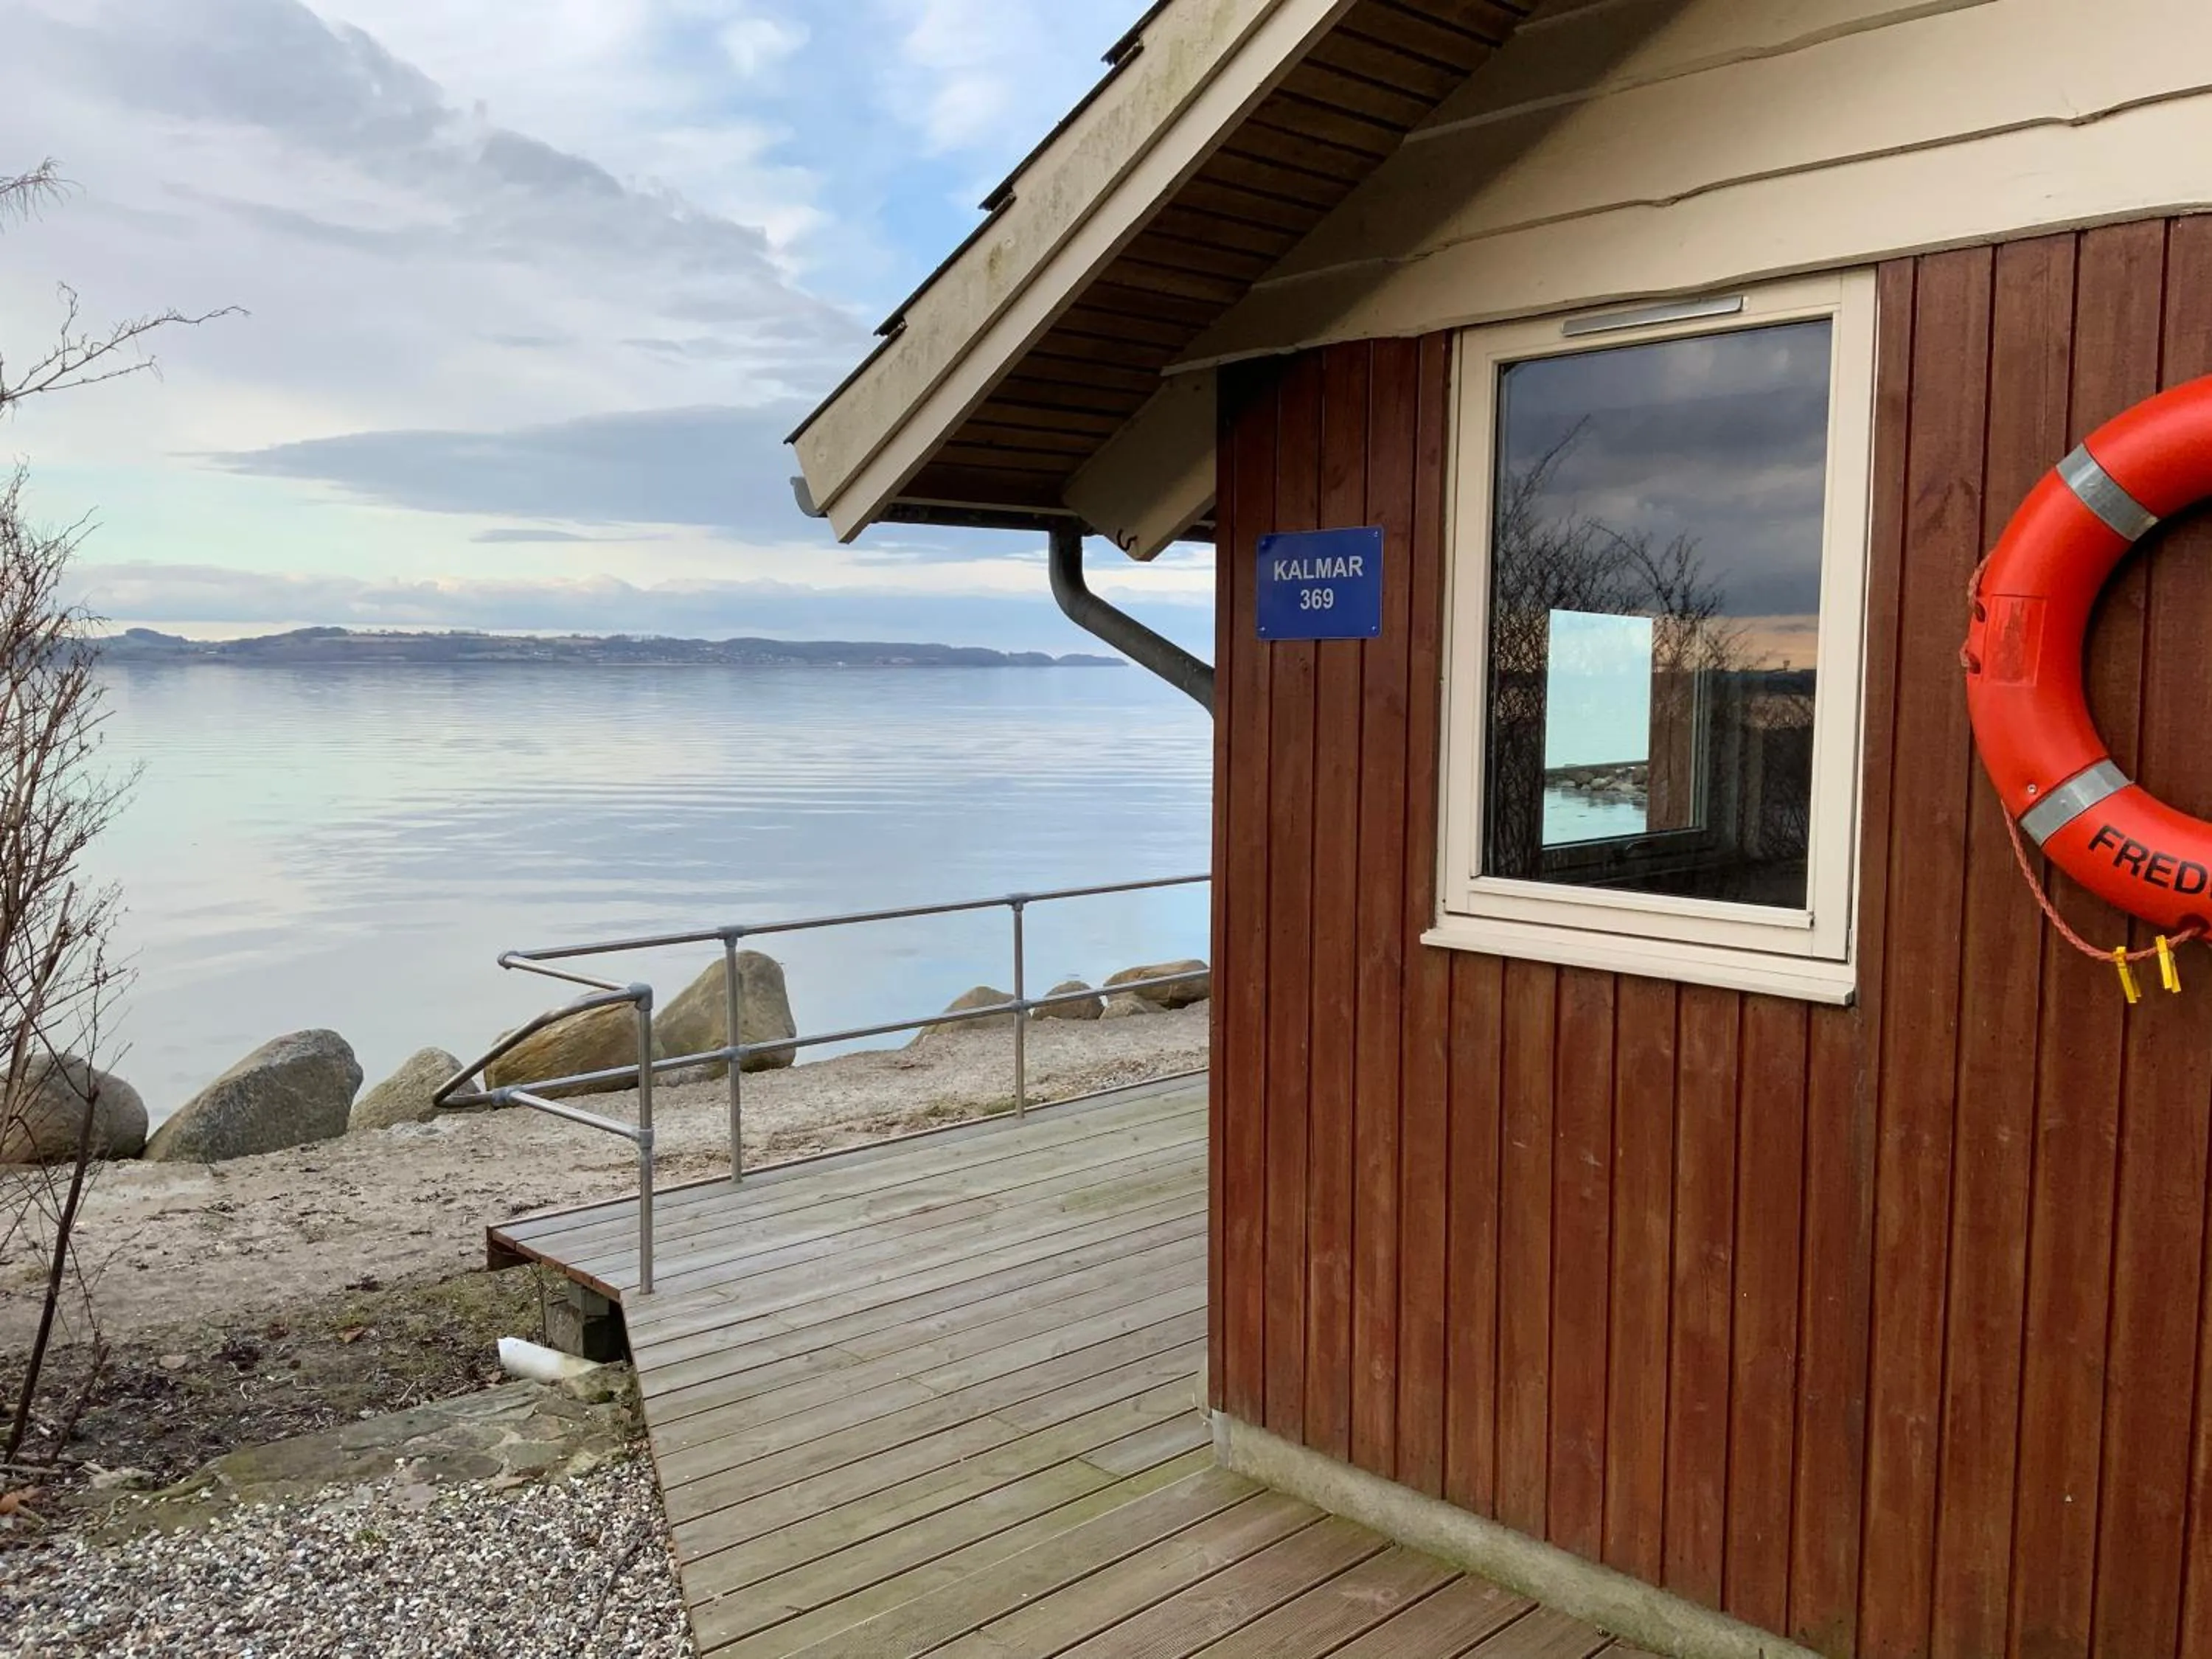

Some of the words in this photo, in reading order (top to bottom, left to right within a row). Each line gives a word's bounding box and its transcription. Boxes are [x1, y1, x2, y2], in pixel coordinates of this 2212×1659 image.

[1273, 555, 1363, 581] KALMAR
[1300, 588, 1335, 610] 369
[2087, 824, 2212, 898] FRED
